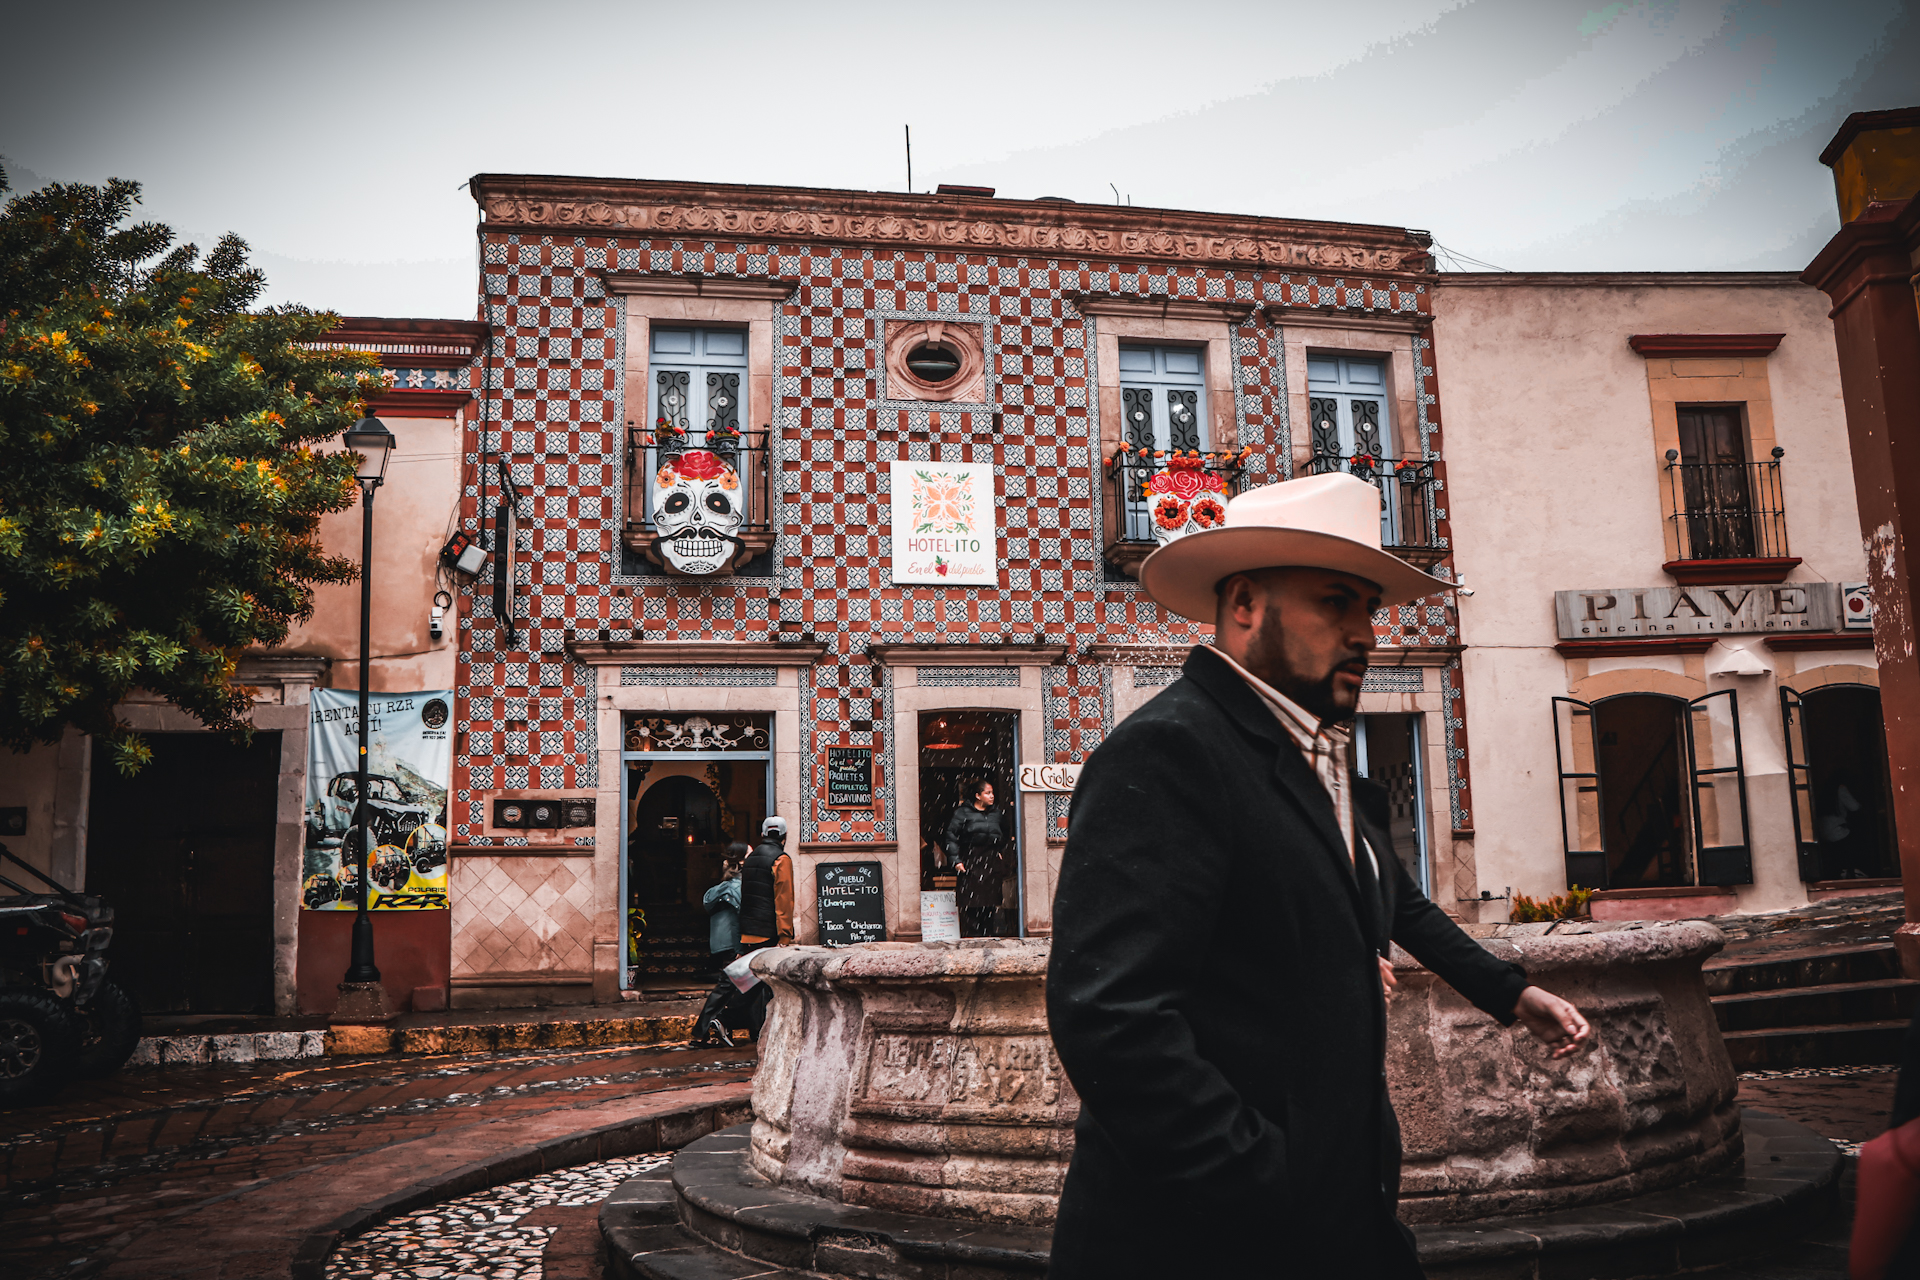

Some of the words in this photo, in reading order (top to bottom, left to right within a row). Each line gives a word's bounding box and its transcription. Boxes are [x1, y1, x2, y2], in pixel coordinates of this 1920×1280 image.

[908, 562, 922, 575] En
[1579, 588, 1807, 621] PIAVE
[1582, 623, 1675, 634] cucina
[1697, 620, 1809, 630] italiana
[386, 699, 414, 713] RZR
[829, 770, 864, 782] PAQUETES
[831, 782, 869, 791] COMPLETOS
[829, 793, 872, 804] DESAYUNOS
[825, 871, 835, 880] EN
[858, 867, 872, 878] DEL
[372, 894, 447, 909] RZR
[824, 920, 845, 930] Tacos
